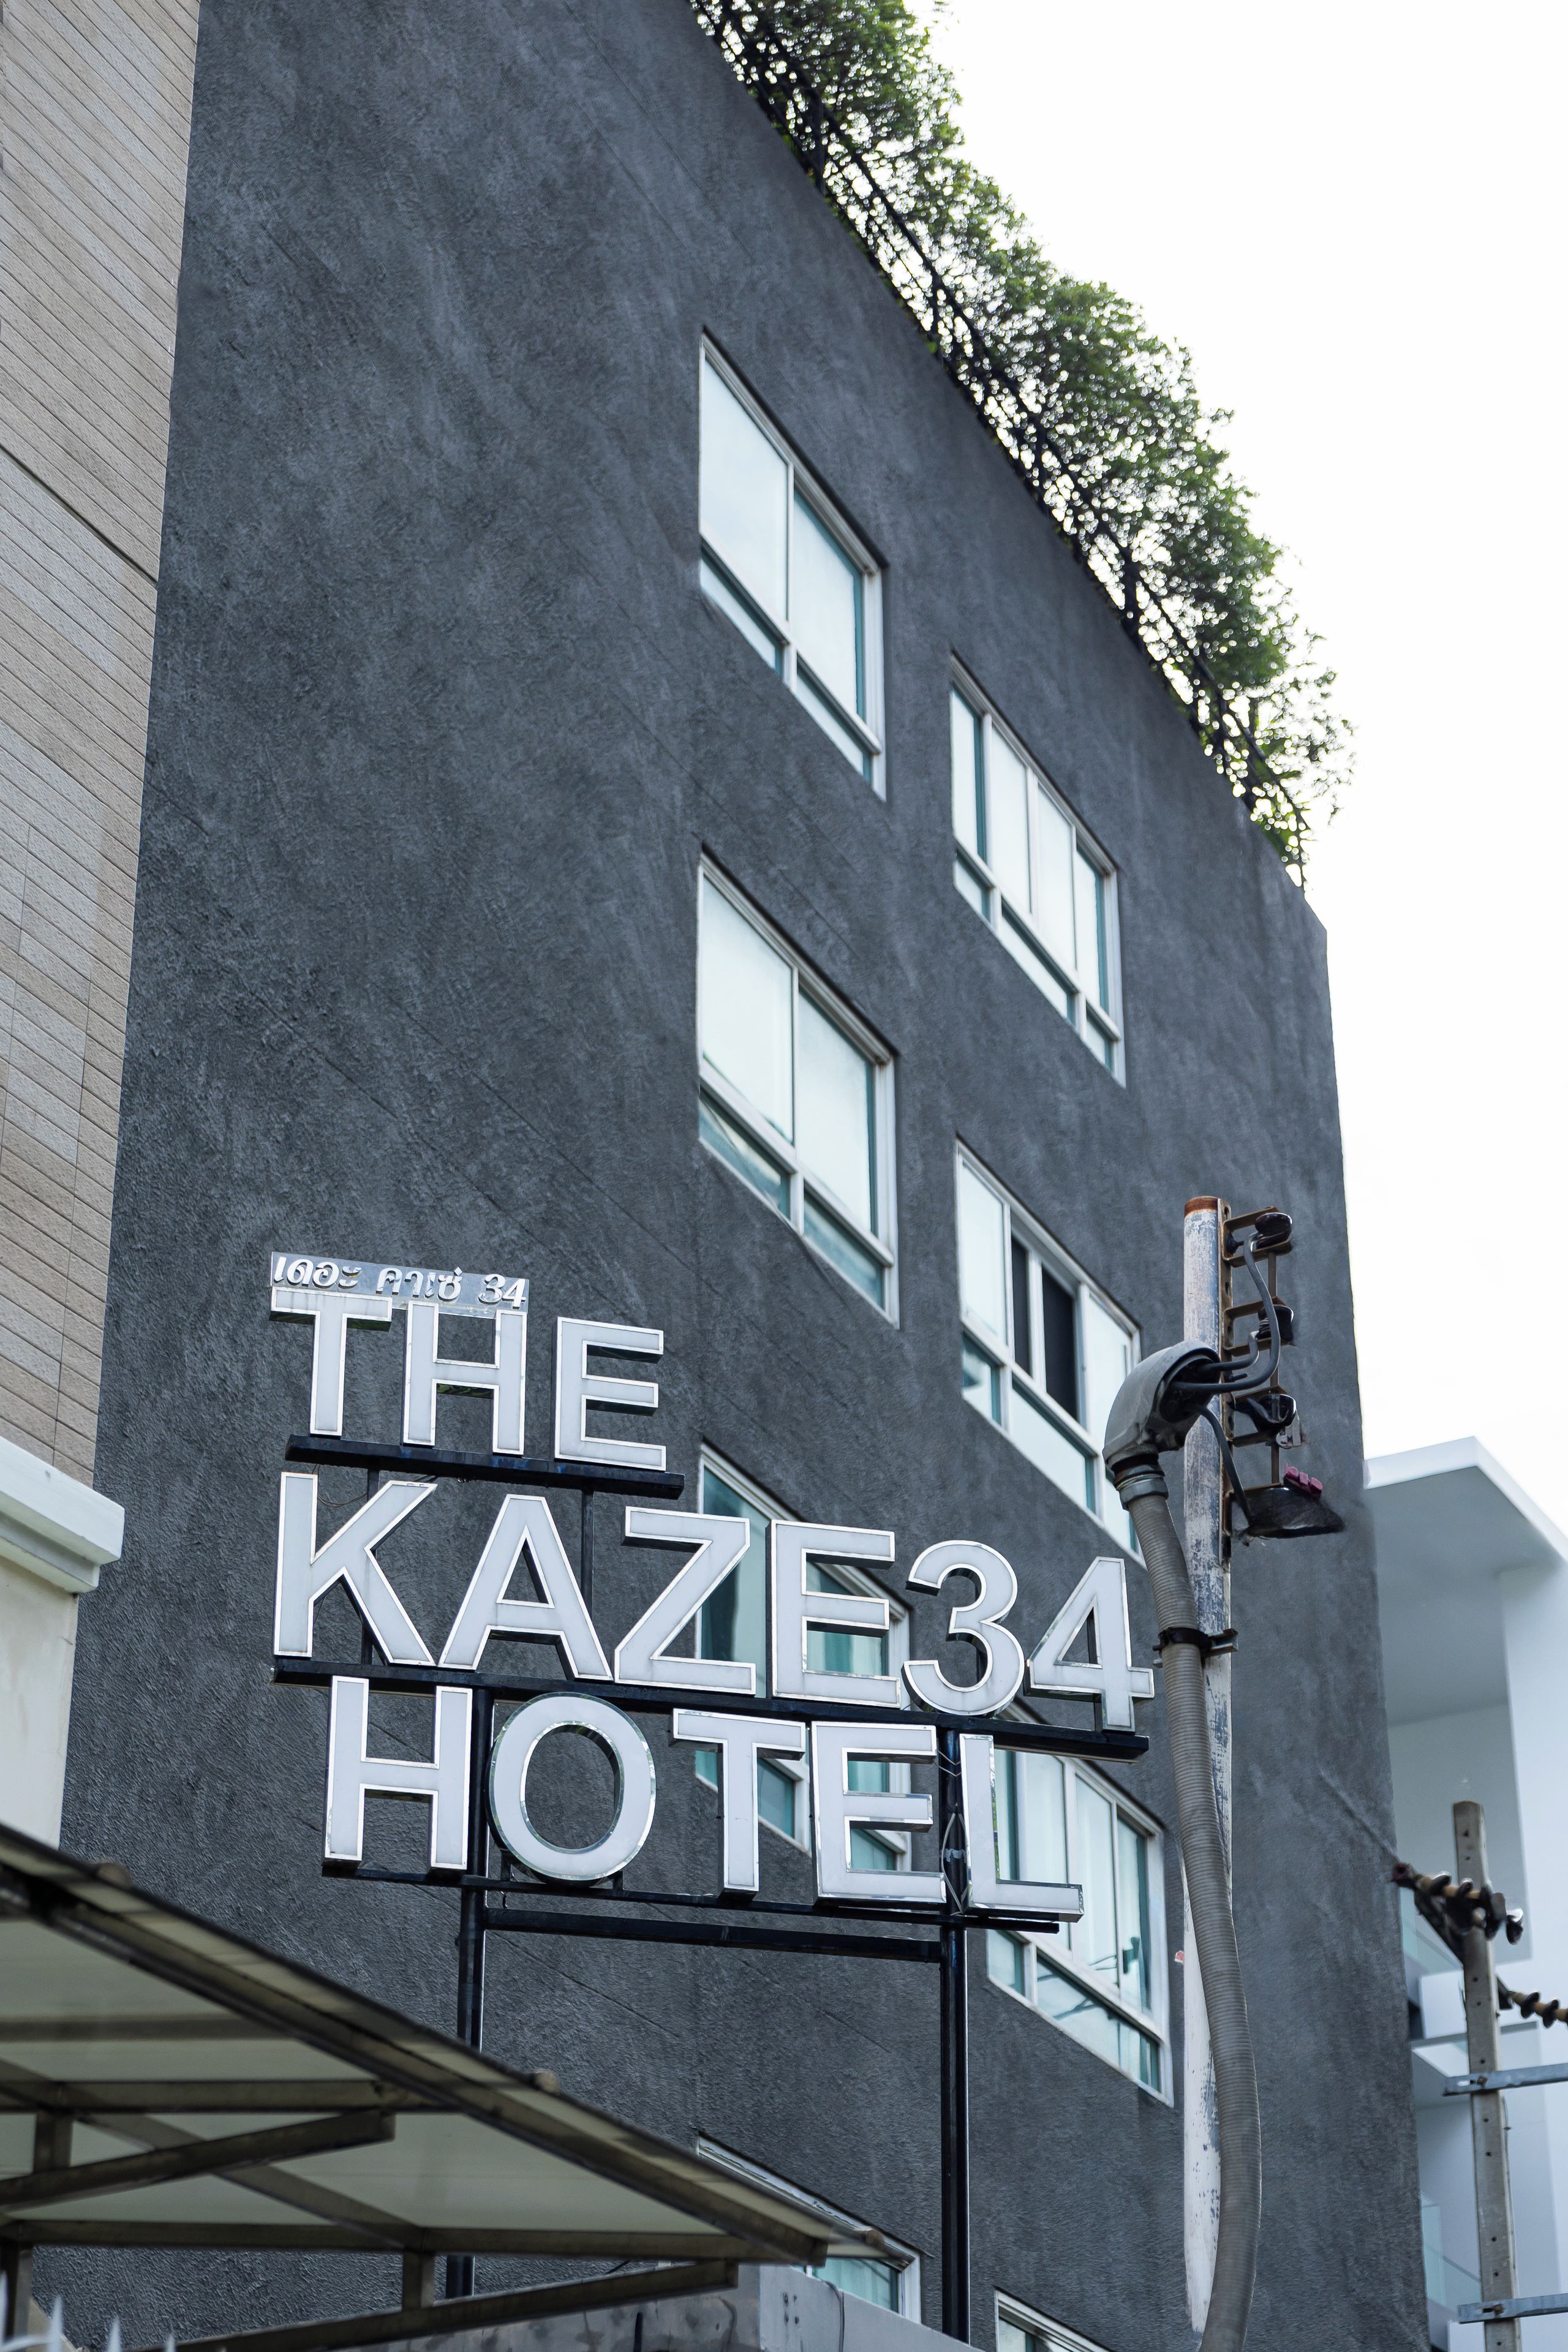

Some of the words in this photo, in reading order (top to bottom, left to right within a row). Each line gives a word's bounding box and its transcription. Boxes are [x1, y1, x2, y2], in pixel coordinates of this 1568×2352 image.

[274, 1256, 362, 1289] เดอะ
[478, 1273, 527, 1309] 34
[270, 1286, 666, 1471] THE
[322, 1675, 1084, 1917] HOTEL
